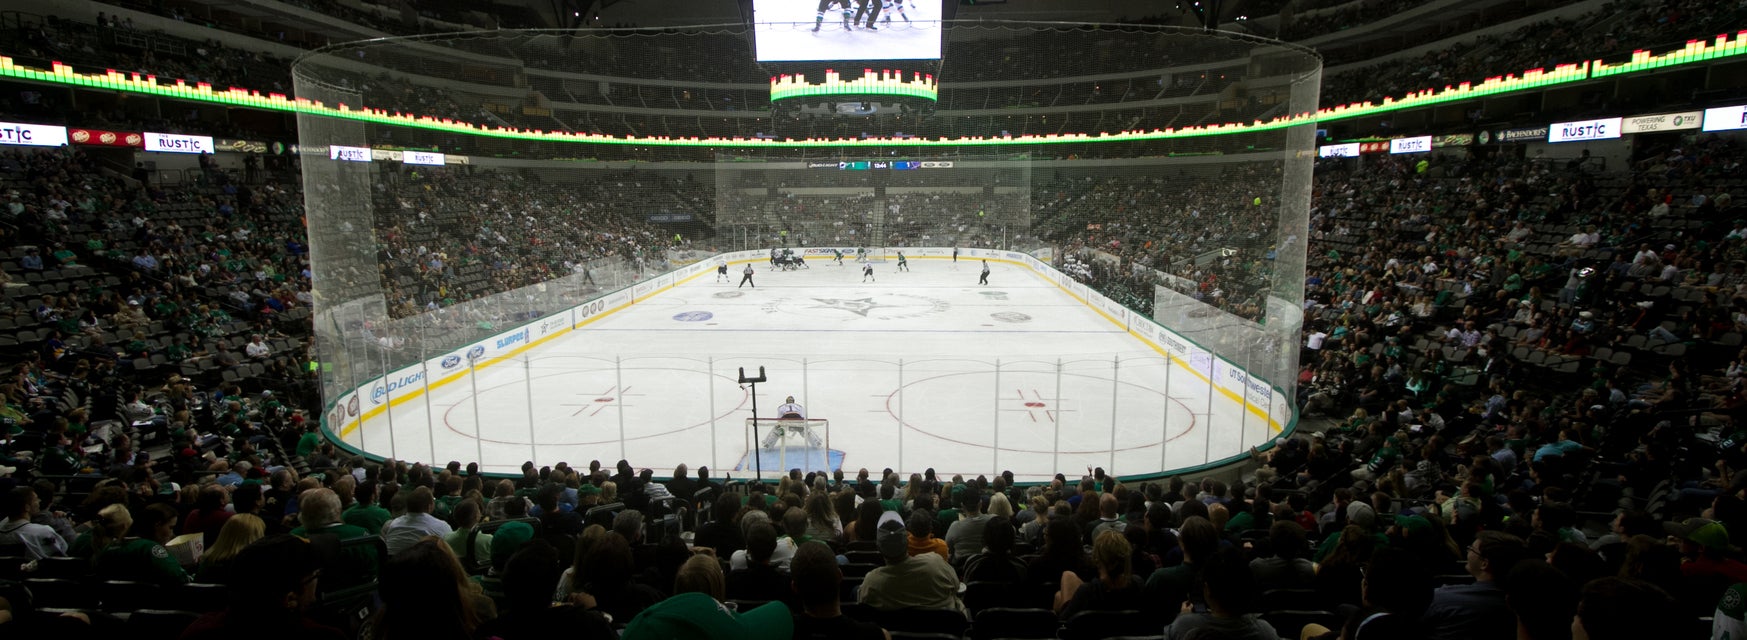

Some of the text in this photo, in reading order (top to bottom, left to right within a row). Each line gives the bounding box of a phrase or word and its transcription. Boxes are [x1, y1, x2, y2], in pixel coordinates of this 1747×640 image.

[1632, 116, 1665, 125] POWERING
[1562, 124, 1606, 137] RUSTIC
[159, 138, 201, 150] RUSTIC
[1399, 140, 1422, 150] RUSTIC
[415, 155, 434, 163] RUSTIC
[375, 382, 397, 399] BUD
